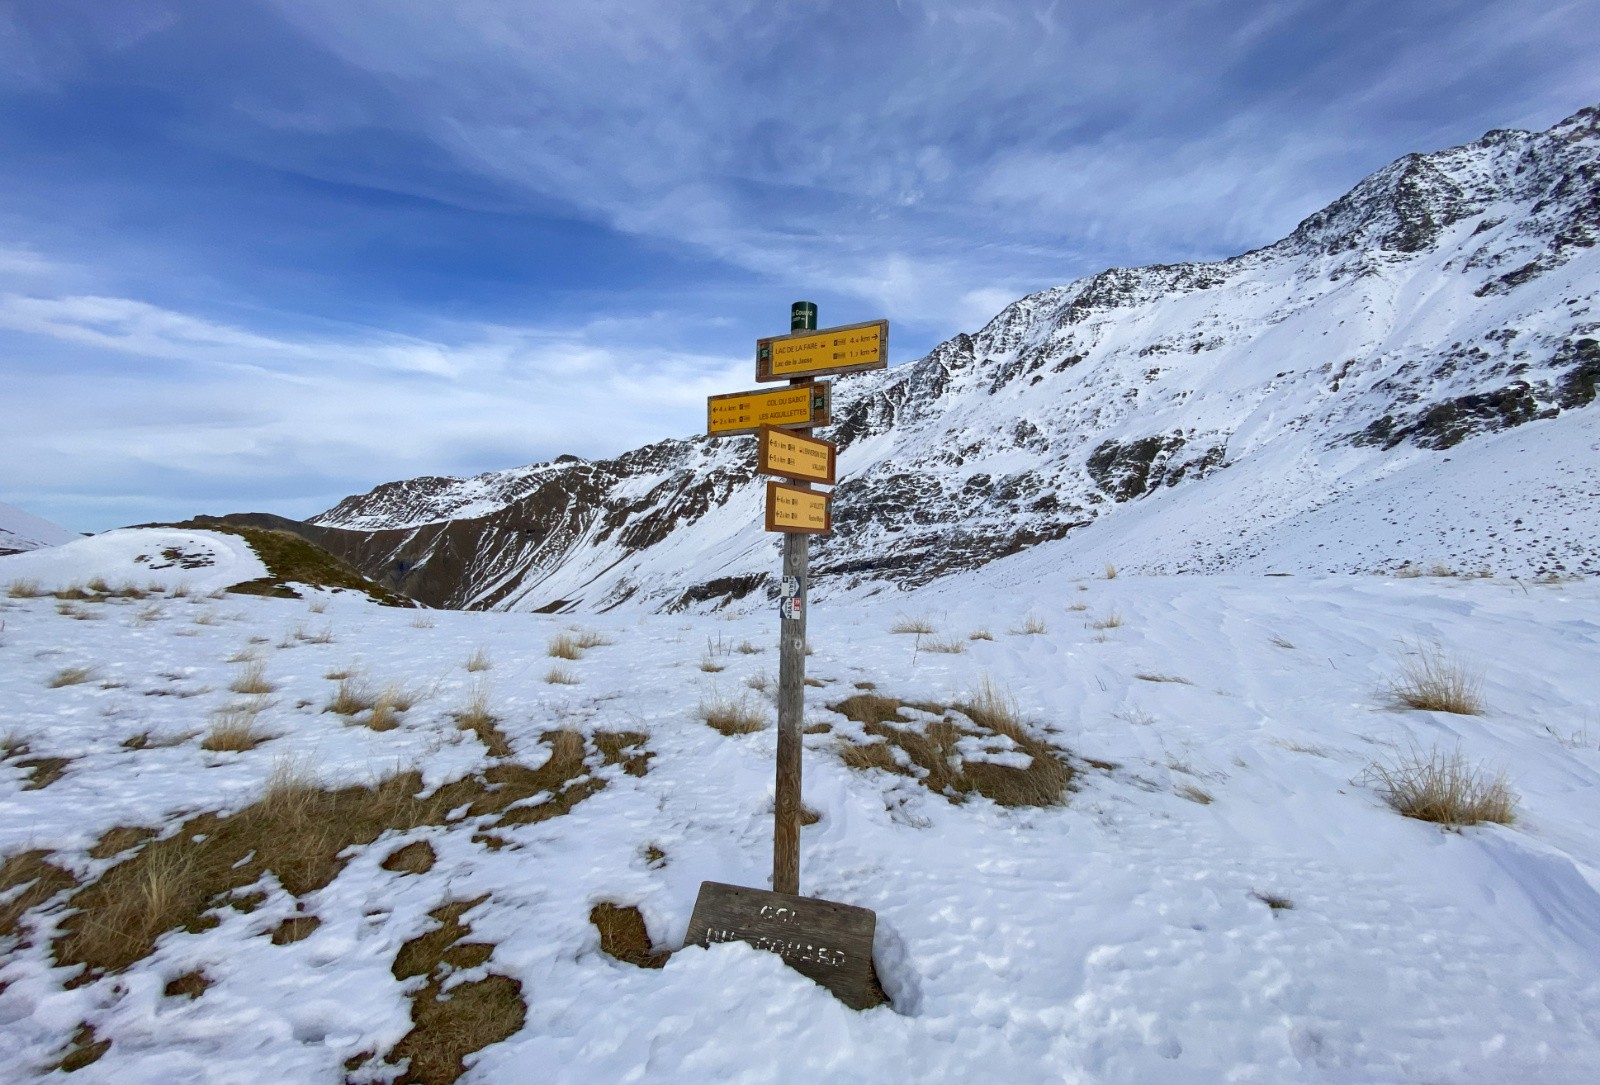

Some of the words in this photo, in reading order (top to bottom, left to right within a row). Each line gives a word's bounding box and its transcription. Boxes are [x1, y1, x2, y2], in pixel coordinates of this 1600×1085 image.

[775, 347, 786, 355] LAC
[787, 345, 795, 353] DE
[796, 344, 803, 352] LA
[803, 342, 818, 351] FARE
[767, 399, 777, 407] COL
[788, 395, 807, 404] SABOT
[760, 905, 800, 926] COL
